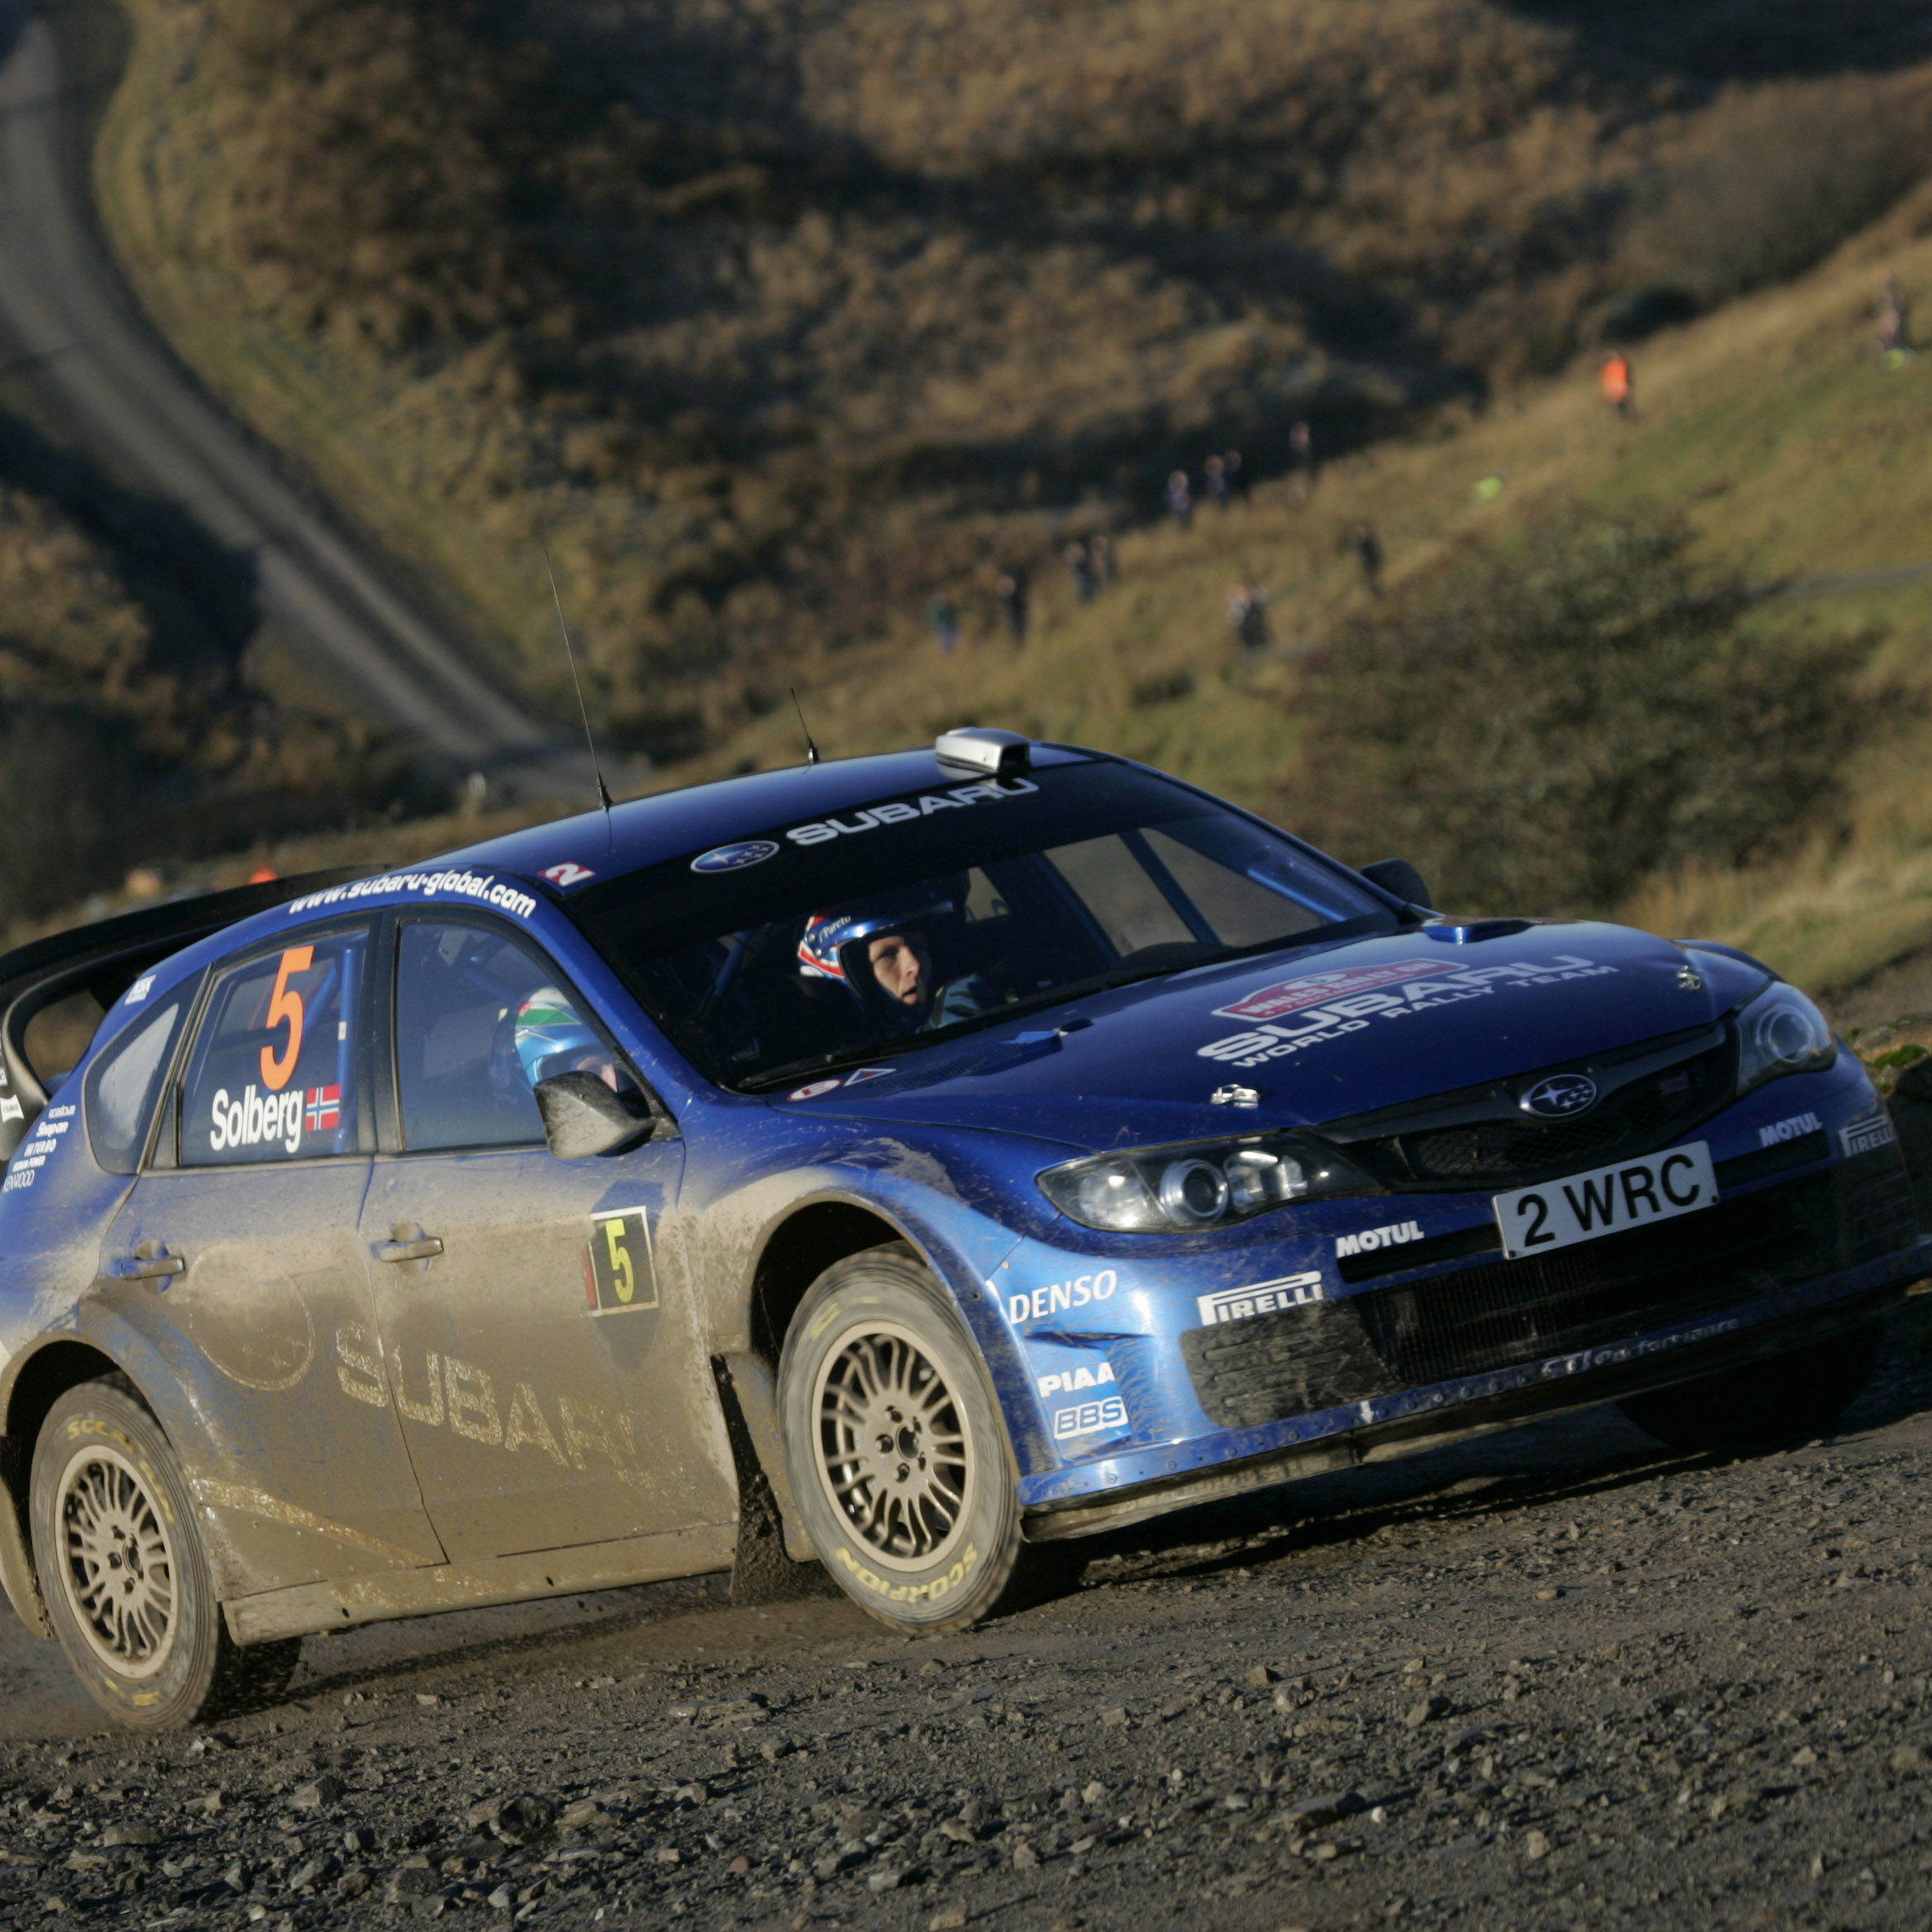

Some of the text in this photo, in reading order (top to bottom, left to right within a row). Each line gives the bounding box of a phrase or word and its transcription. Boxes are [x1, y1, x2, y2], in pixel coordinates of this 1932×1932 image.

[786, 777, 1040, 845] SUBARU
[261, 944, 314, 1091] 5
[1197, 955, 1595, 1061] SUBARU
[1232, 1020, 1370, 1068] WORLD
[1380, 986, 1495, 1019] RALLY
[1506, 965, 1620, 988] TEAM
[210, 1085, 304, 1154] Solberg
[1759, 1112, 1823, 1148] MOTUL
[1838, 1113, 1896, 1158] PIRELLI
[1517, 1153, 1700, 1247] 2 WRC
[605, 1218, 634, 1303] 5
[1336, 1220, 1424, 1258] MOTUL
[1009, 1270, 1117, 1325] DENSO
[1197, 1270, 1323, 1326] PIRELLI
[1037, 1361, 1116, 1398] PIAA
[1055, 1398, 1126, 1438] BBS
